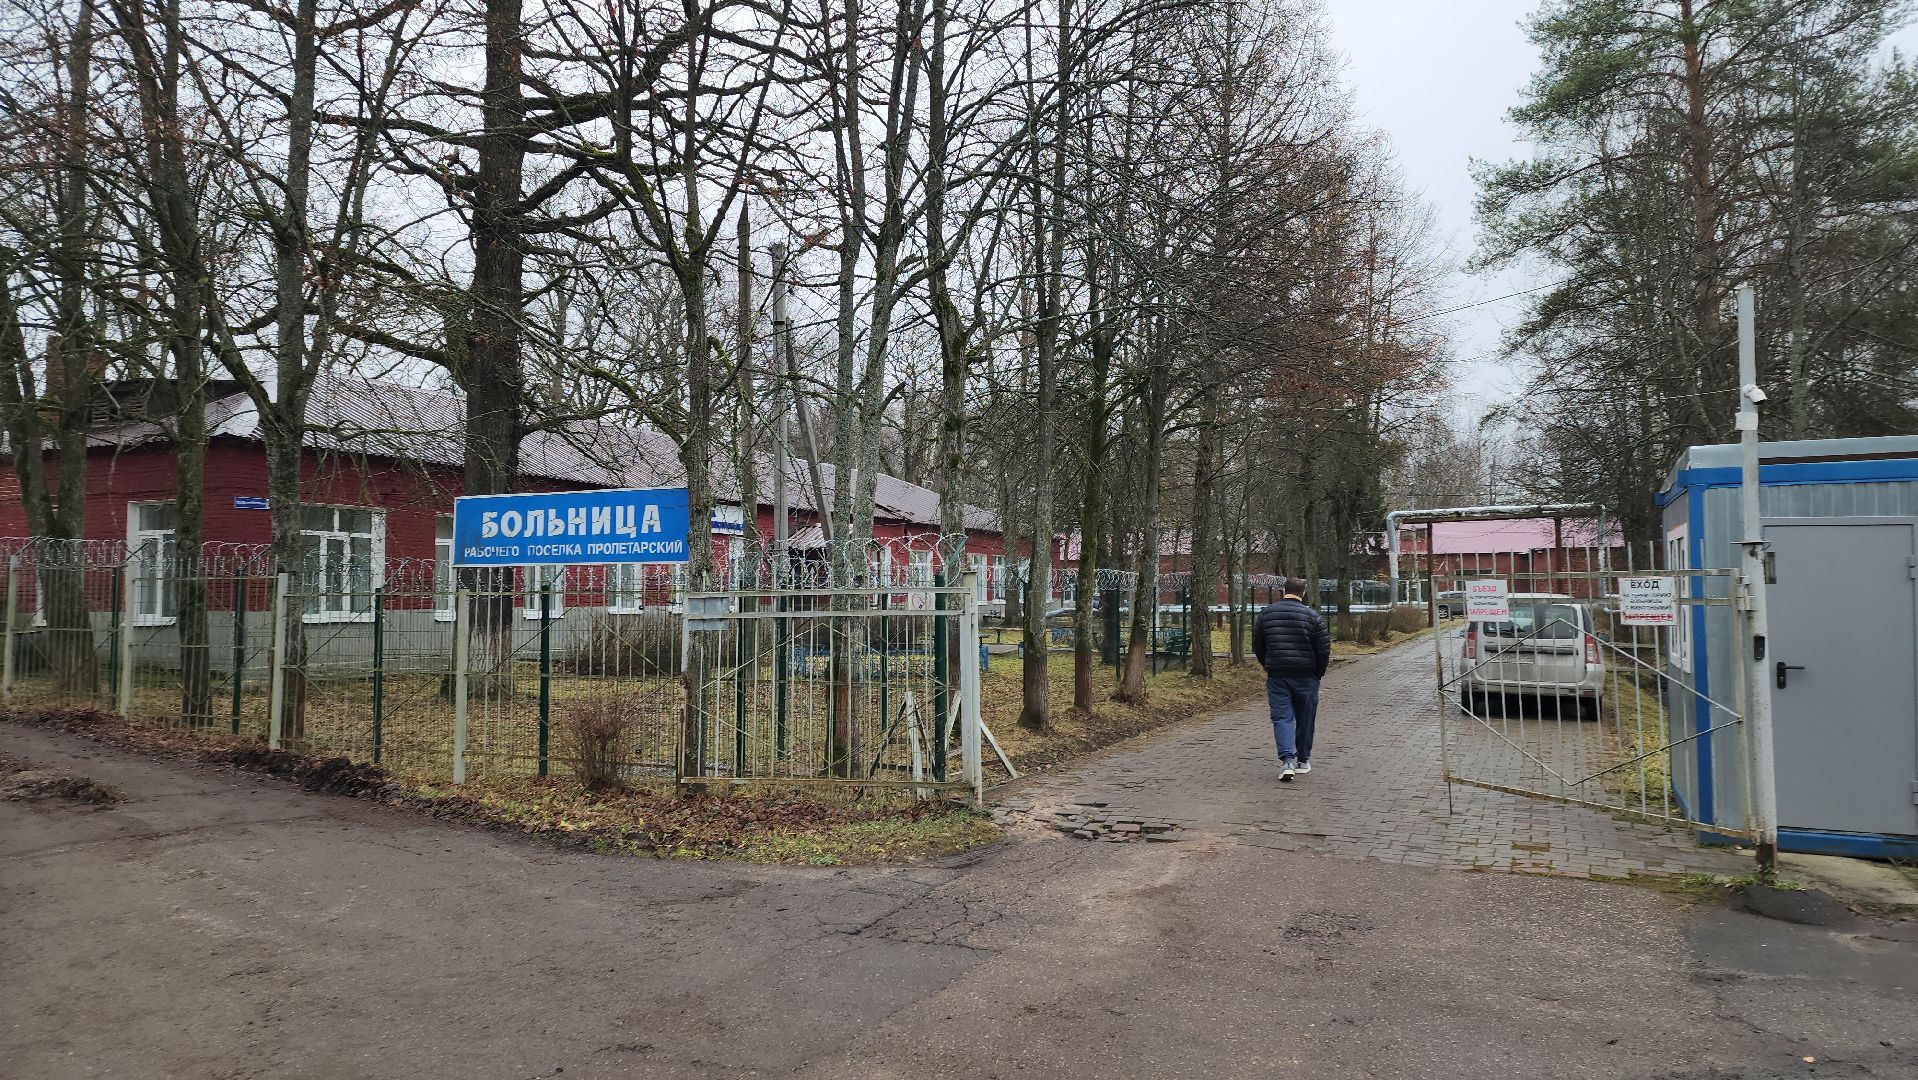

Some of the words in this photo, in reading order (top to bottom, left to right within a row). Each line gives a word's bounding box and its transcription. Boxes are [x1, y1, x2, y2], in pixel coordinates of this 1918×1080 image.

[482, 504, 662, 539] БОЛЬНИЦА
[464, 545, 520, 558] РАБОЧЕГО
[527, 543, 582, 557] ПОСЕЛКА
[587, 539, 683, 556] ПРОЛЕТАРСКИЙ
[1630, 580, 1660, 590] ВХОД
